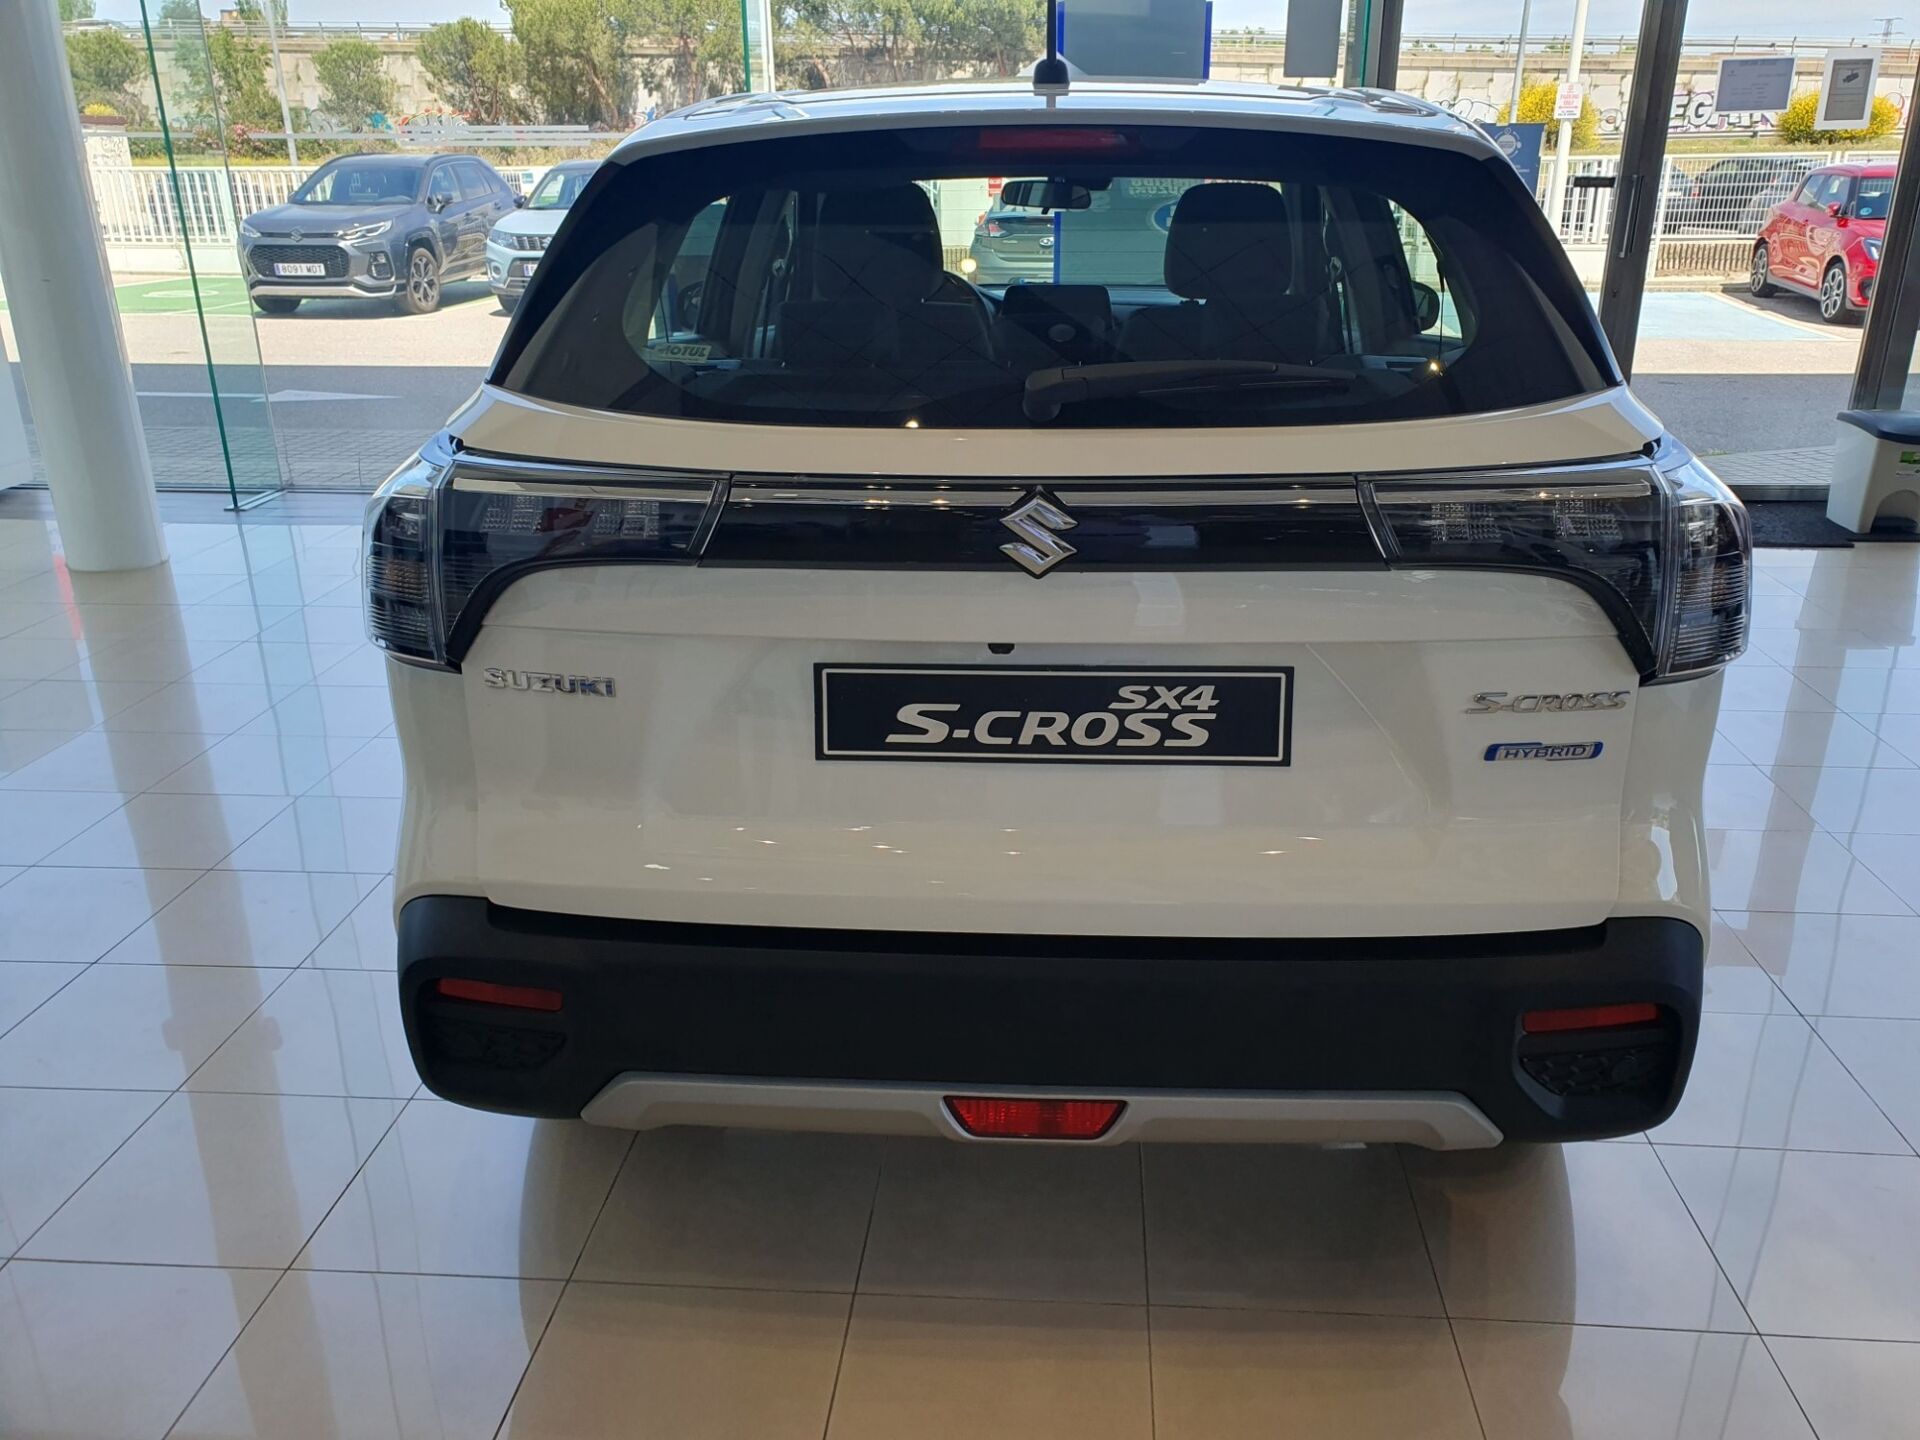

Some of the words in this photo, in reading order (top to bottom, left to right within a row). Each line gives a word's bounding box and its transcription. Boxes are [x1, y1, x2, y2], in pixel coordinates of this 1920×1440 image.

[281, 264, 303, 274] 8091
[483, 667, 617, 698] SUZUKI
[1107, 684, 1220, 711] SX4
[1464, 690, 1632, 714] S-CROSS
[884, 702, 1217, 747] S-CROSS
[1503, 744, 1588, 759] HYBRID
